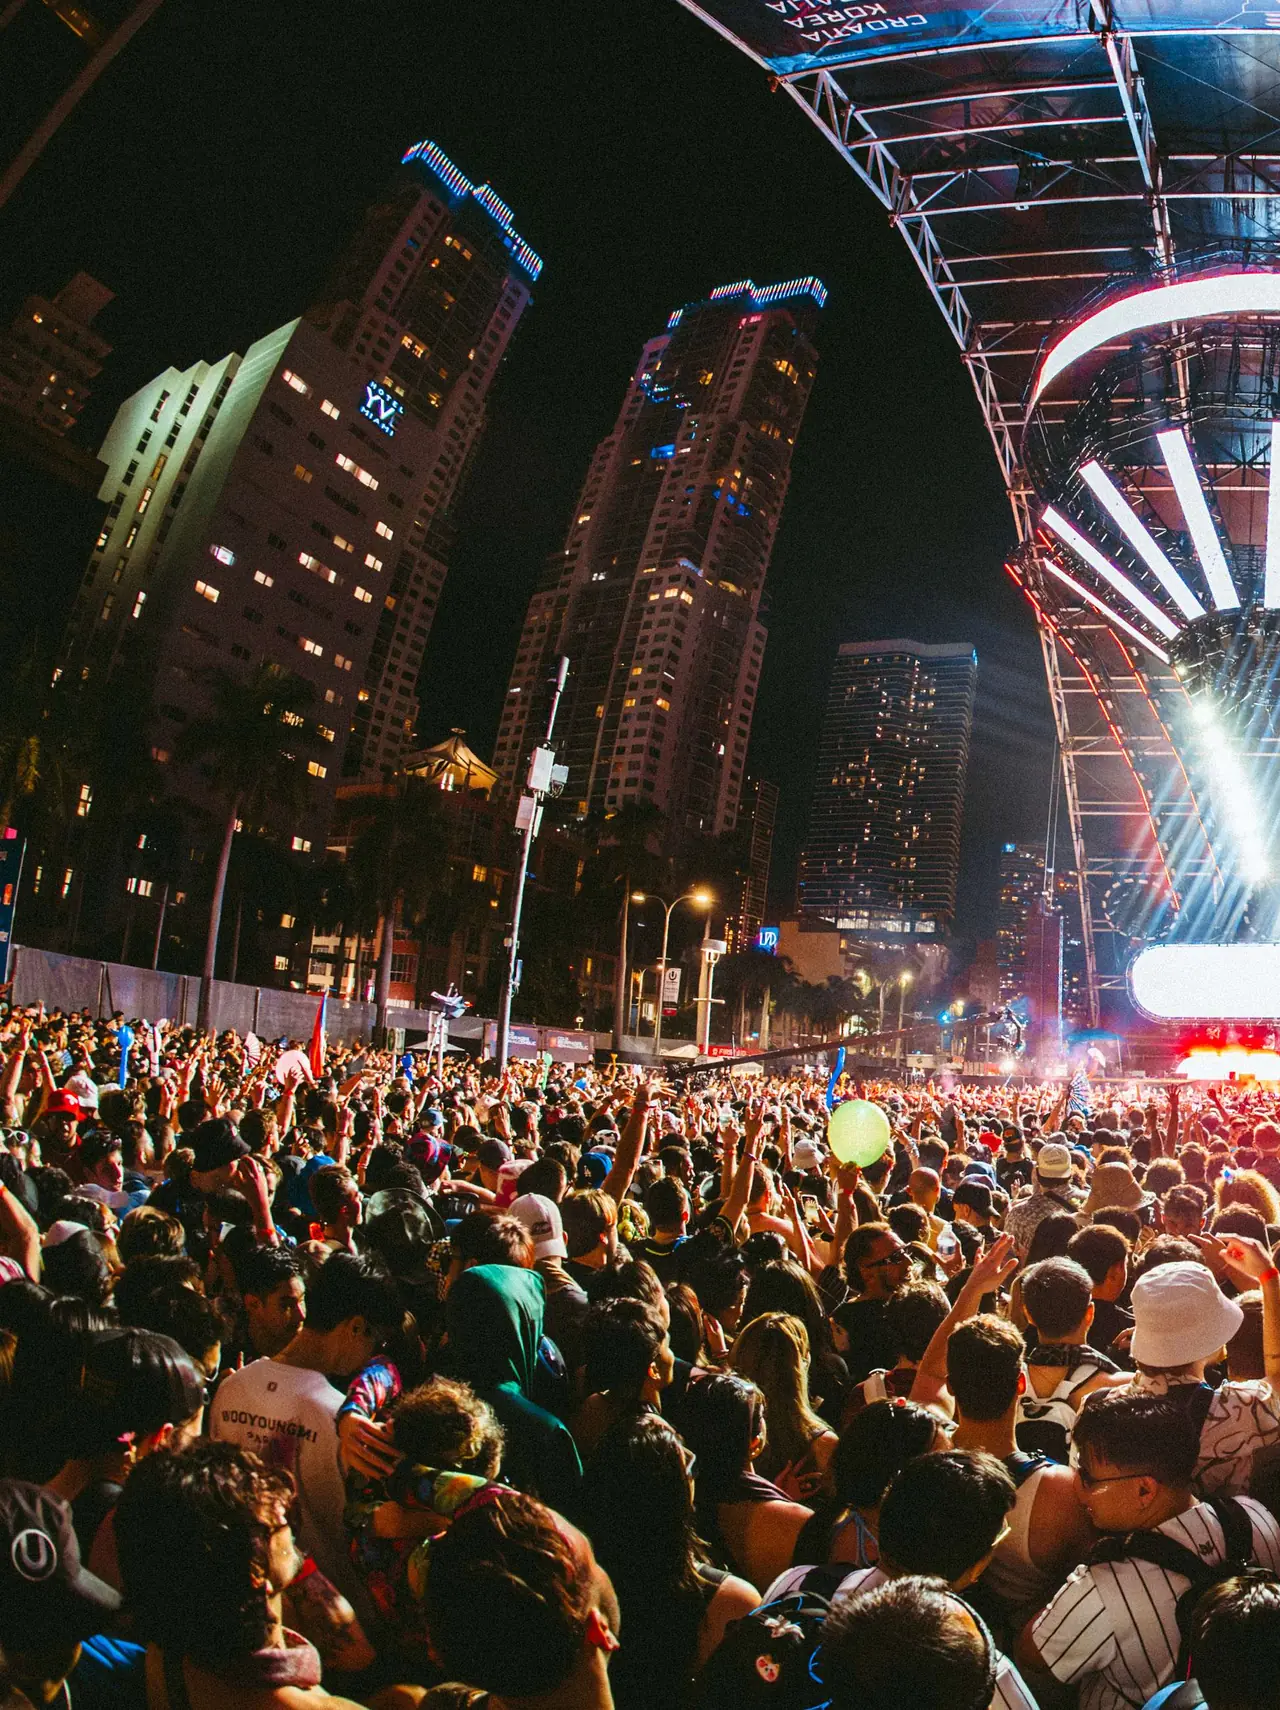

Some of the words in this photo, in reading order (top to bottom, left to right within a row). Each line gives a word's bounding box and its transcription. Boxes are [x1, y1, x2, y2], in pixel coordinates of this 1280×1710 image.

[783, 3, 887, 29] KOREA
[800, 14, 928, 42] CROATIA
[369, 381, 404, 415] HOTEL
[360, 406, 395, 437] MIAMI
